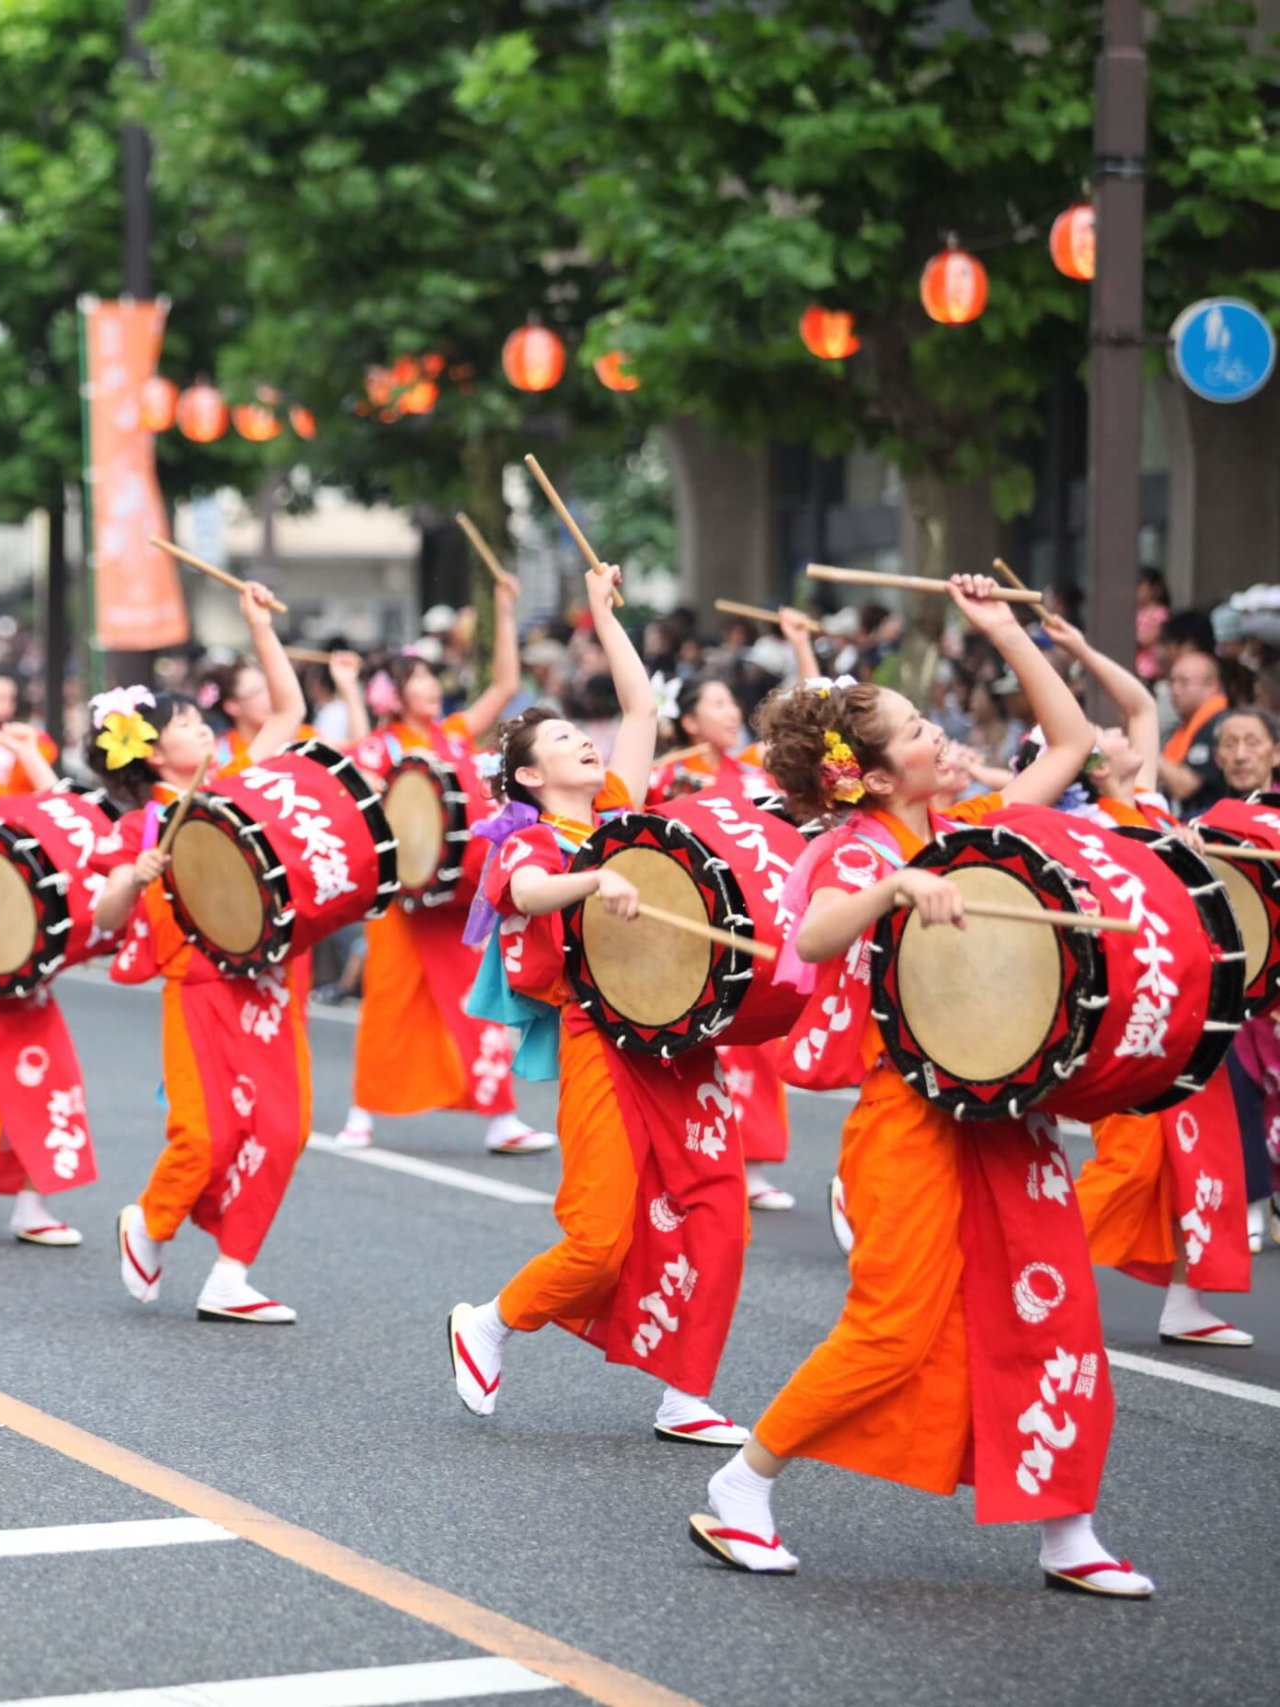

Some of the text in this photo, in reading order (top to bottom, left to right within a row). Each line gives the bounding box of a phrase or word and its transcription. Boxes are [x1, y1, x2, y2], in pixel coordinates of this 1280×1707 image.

[240, 766, 358, 905] ミス太鼓
[696, 797, 795, 940] ミス太
[1067, 829, 1179, 1058] ミス太鼓
[631, 1253, 689, 1358] さんさ
[1073, 1352, 1098, 1400] 盛岡
[1016, 1345, 1078, 1495] さんさ
